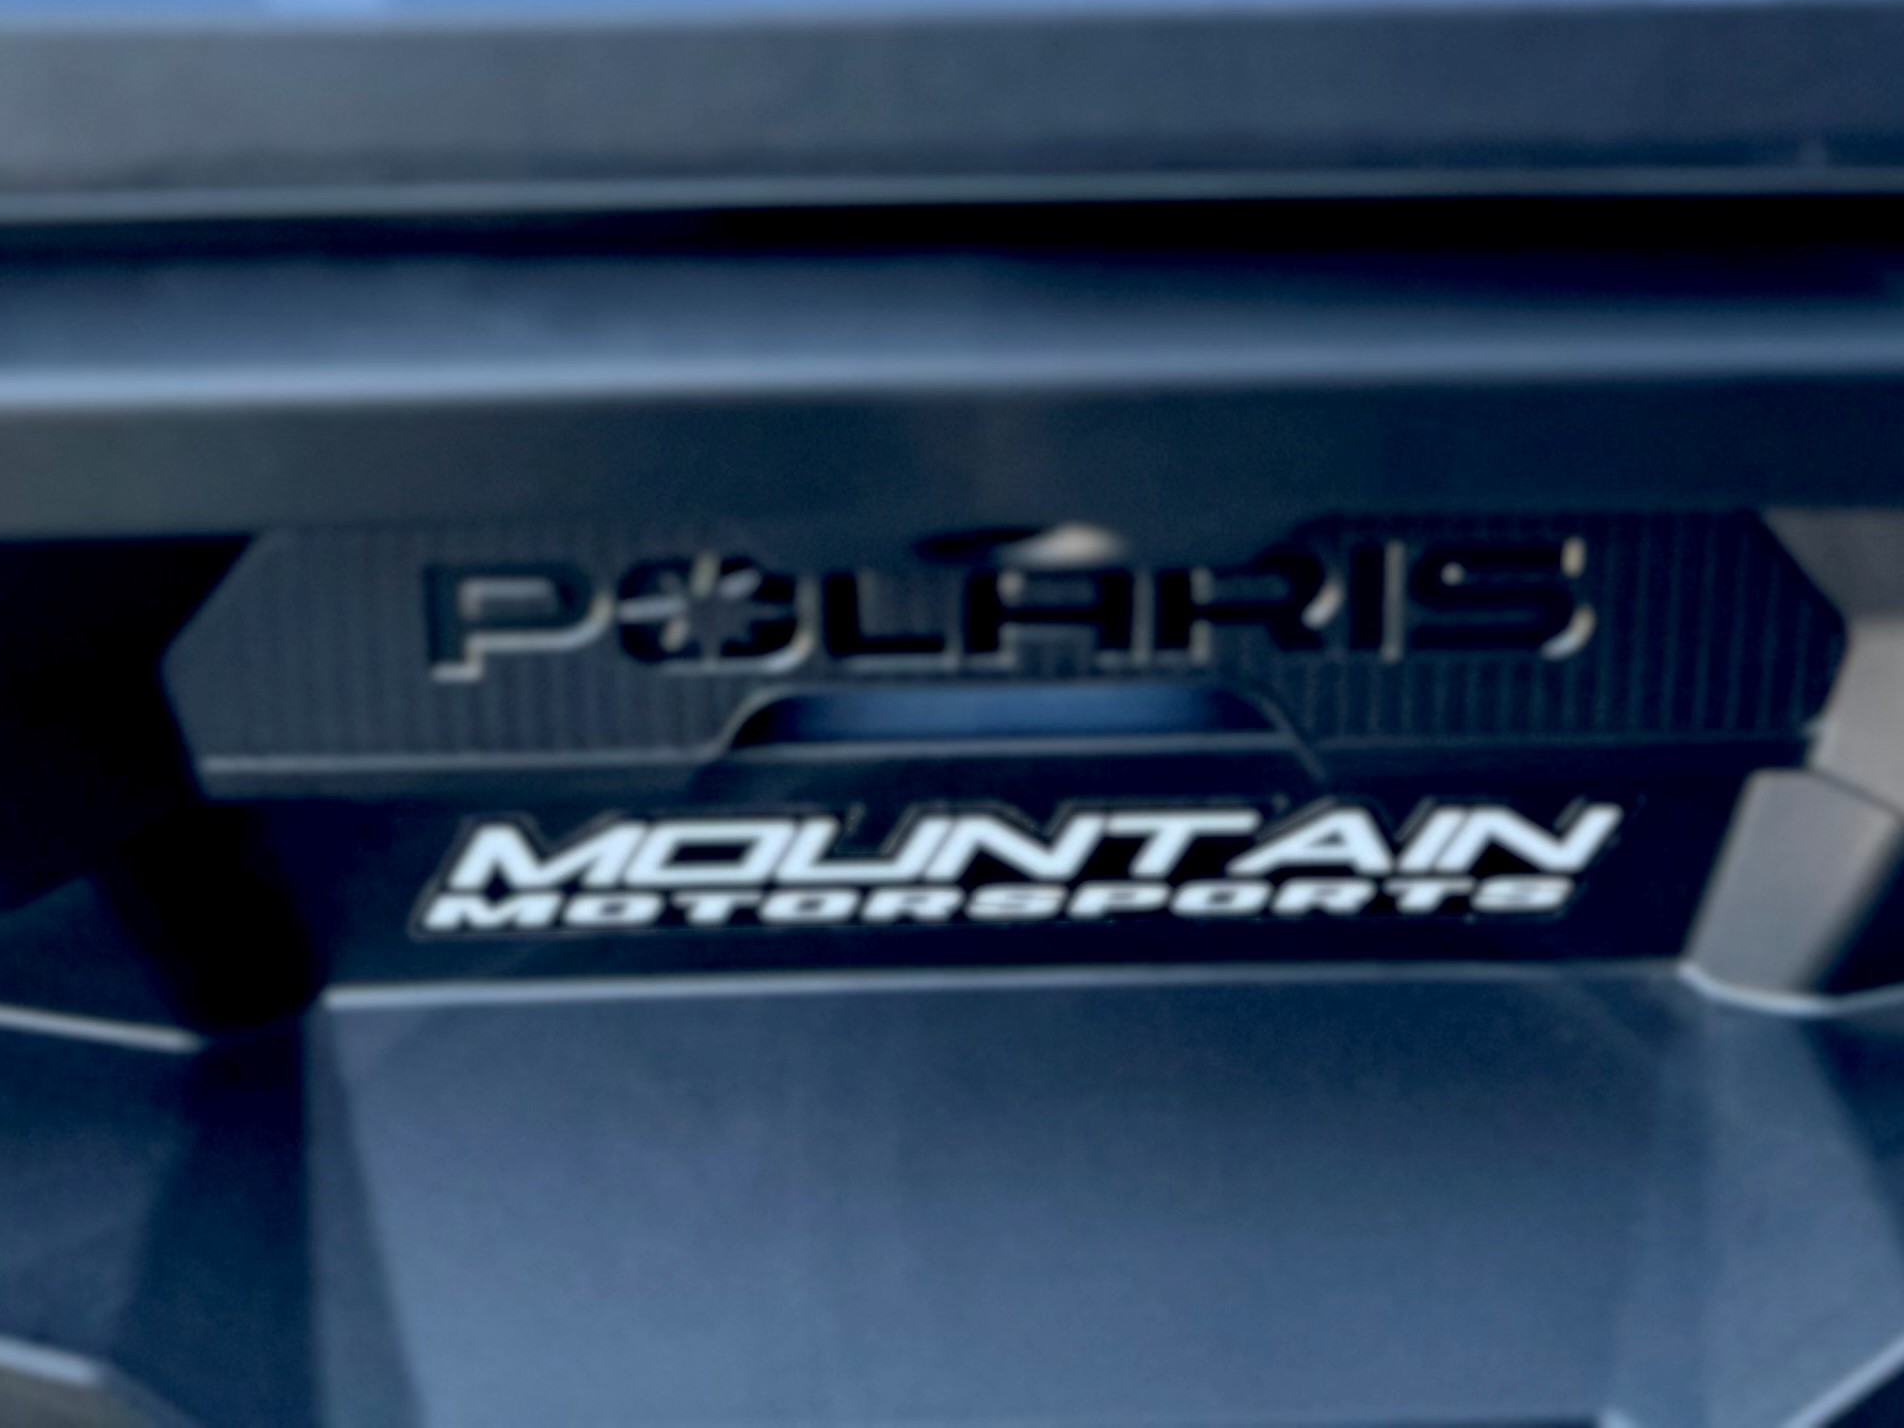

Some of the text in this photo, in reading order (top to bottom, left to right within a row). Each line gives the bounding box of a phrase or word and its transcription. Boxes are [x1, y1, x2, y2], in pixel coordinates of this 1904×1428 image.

[424, 537, 1599, 682] POLARIS
[444, 804, 1624, 890] MOUNTAIN
[420, 874, 1578, 932] MOTORSPORTS
